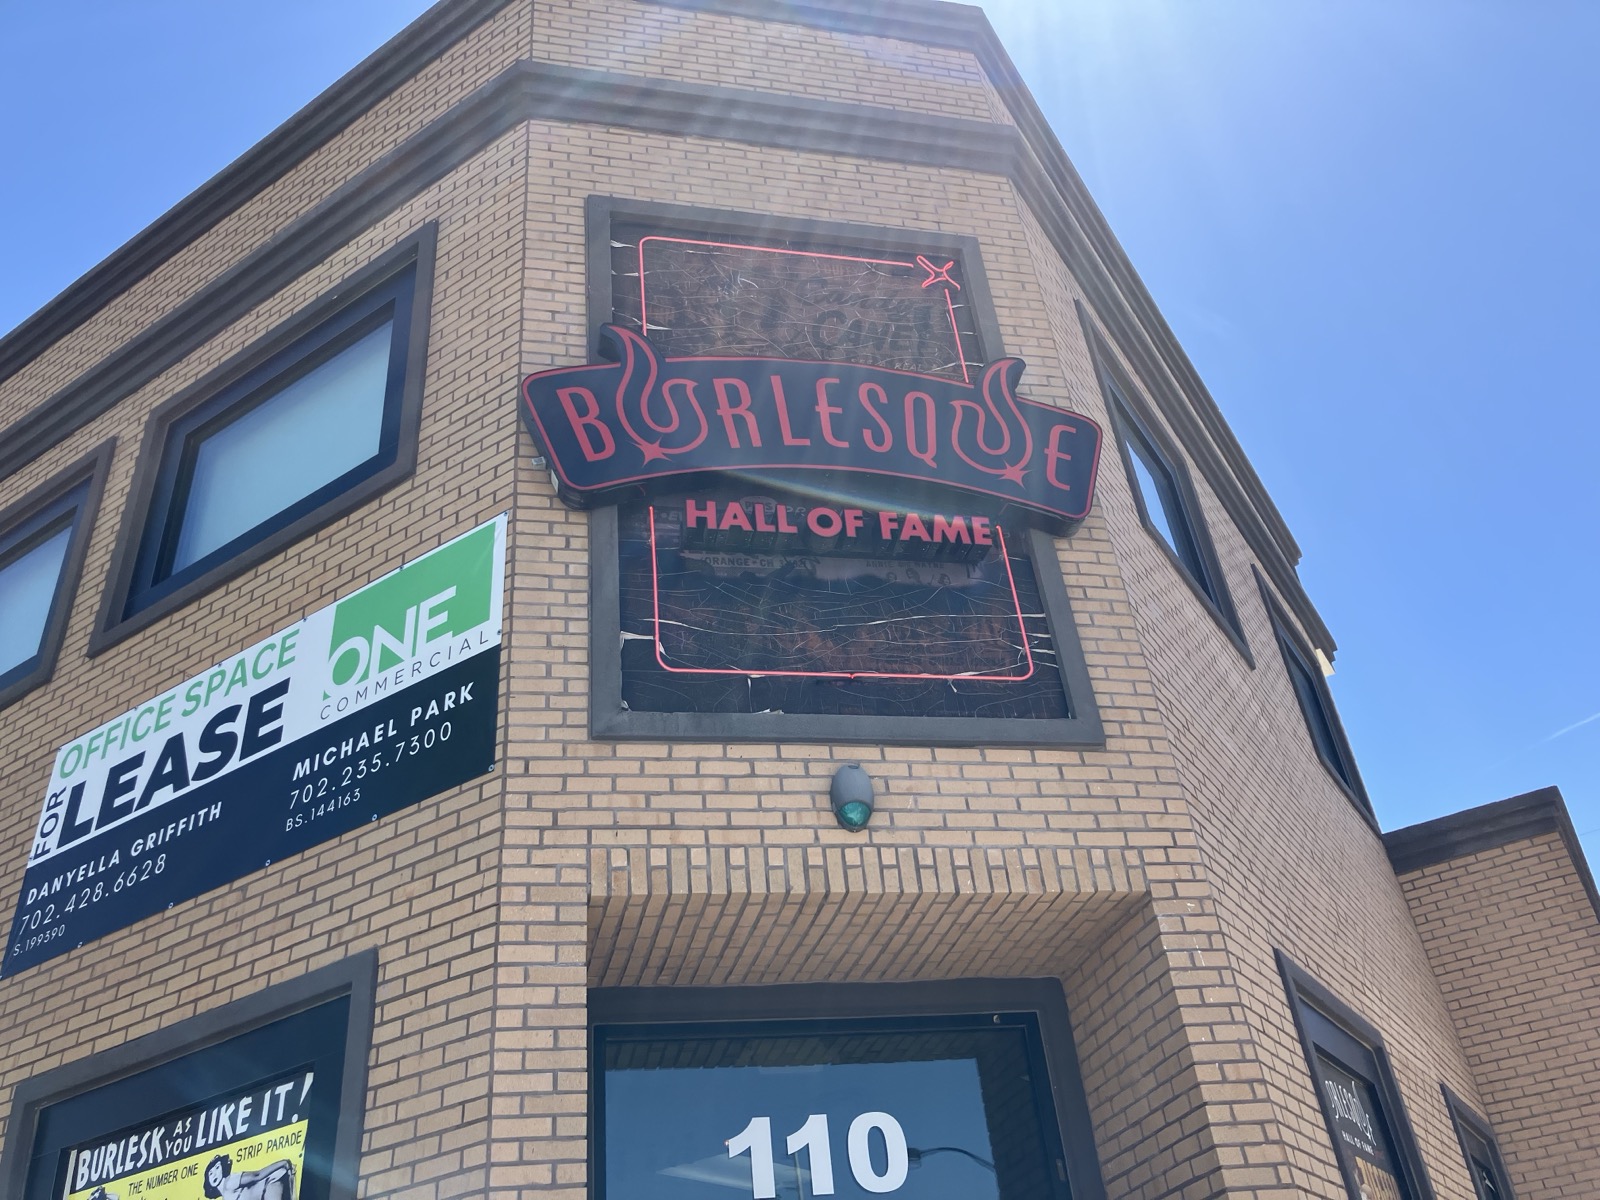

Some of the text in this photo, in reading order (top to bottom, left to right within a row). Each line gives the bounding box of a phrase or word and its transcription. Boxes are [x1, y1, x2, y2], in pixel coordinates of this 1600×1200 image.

[556, 326, 1077, 491] BURLESQUE
[686, 499, 993, 545] HALL OF FAME
[320, 632, 489, 720] COMMERCIAL
[326, 584, 458, 692] ONE
[59, 628, 300, 779] OFFICE SPACE
[292, 682, 474, 781] MICHAEL PARK
[56, 677, 292, 849] LEASE
[289, 721, 452, 810] 702.235.7300
[26, 801, 222, 905] DANYELLA GRIFFITH
[33, 786, 67, 861] FOR
[285, 788, 361, 832] BS.144163
[19, 853, 166, 936] 702.428.6628
[13, 924, 66, 956] S.199390
[75, 1072, 315, 1190] BURLESK AS YOU LIKE IT!
[128, 1180, 144, 1197] THE
[145, 1169, 179, 1191] NUMBER
[181, 1163, 199, 1180] ONE
[236, 1142, 263, 1163] STRIP
[728, 1111, 909, 1200] 110
